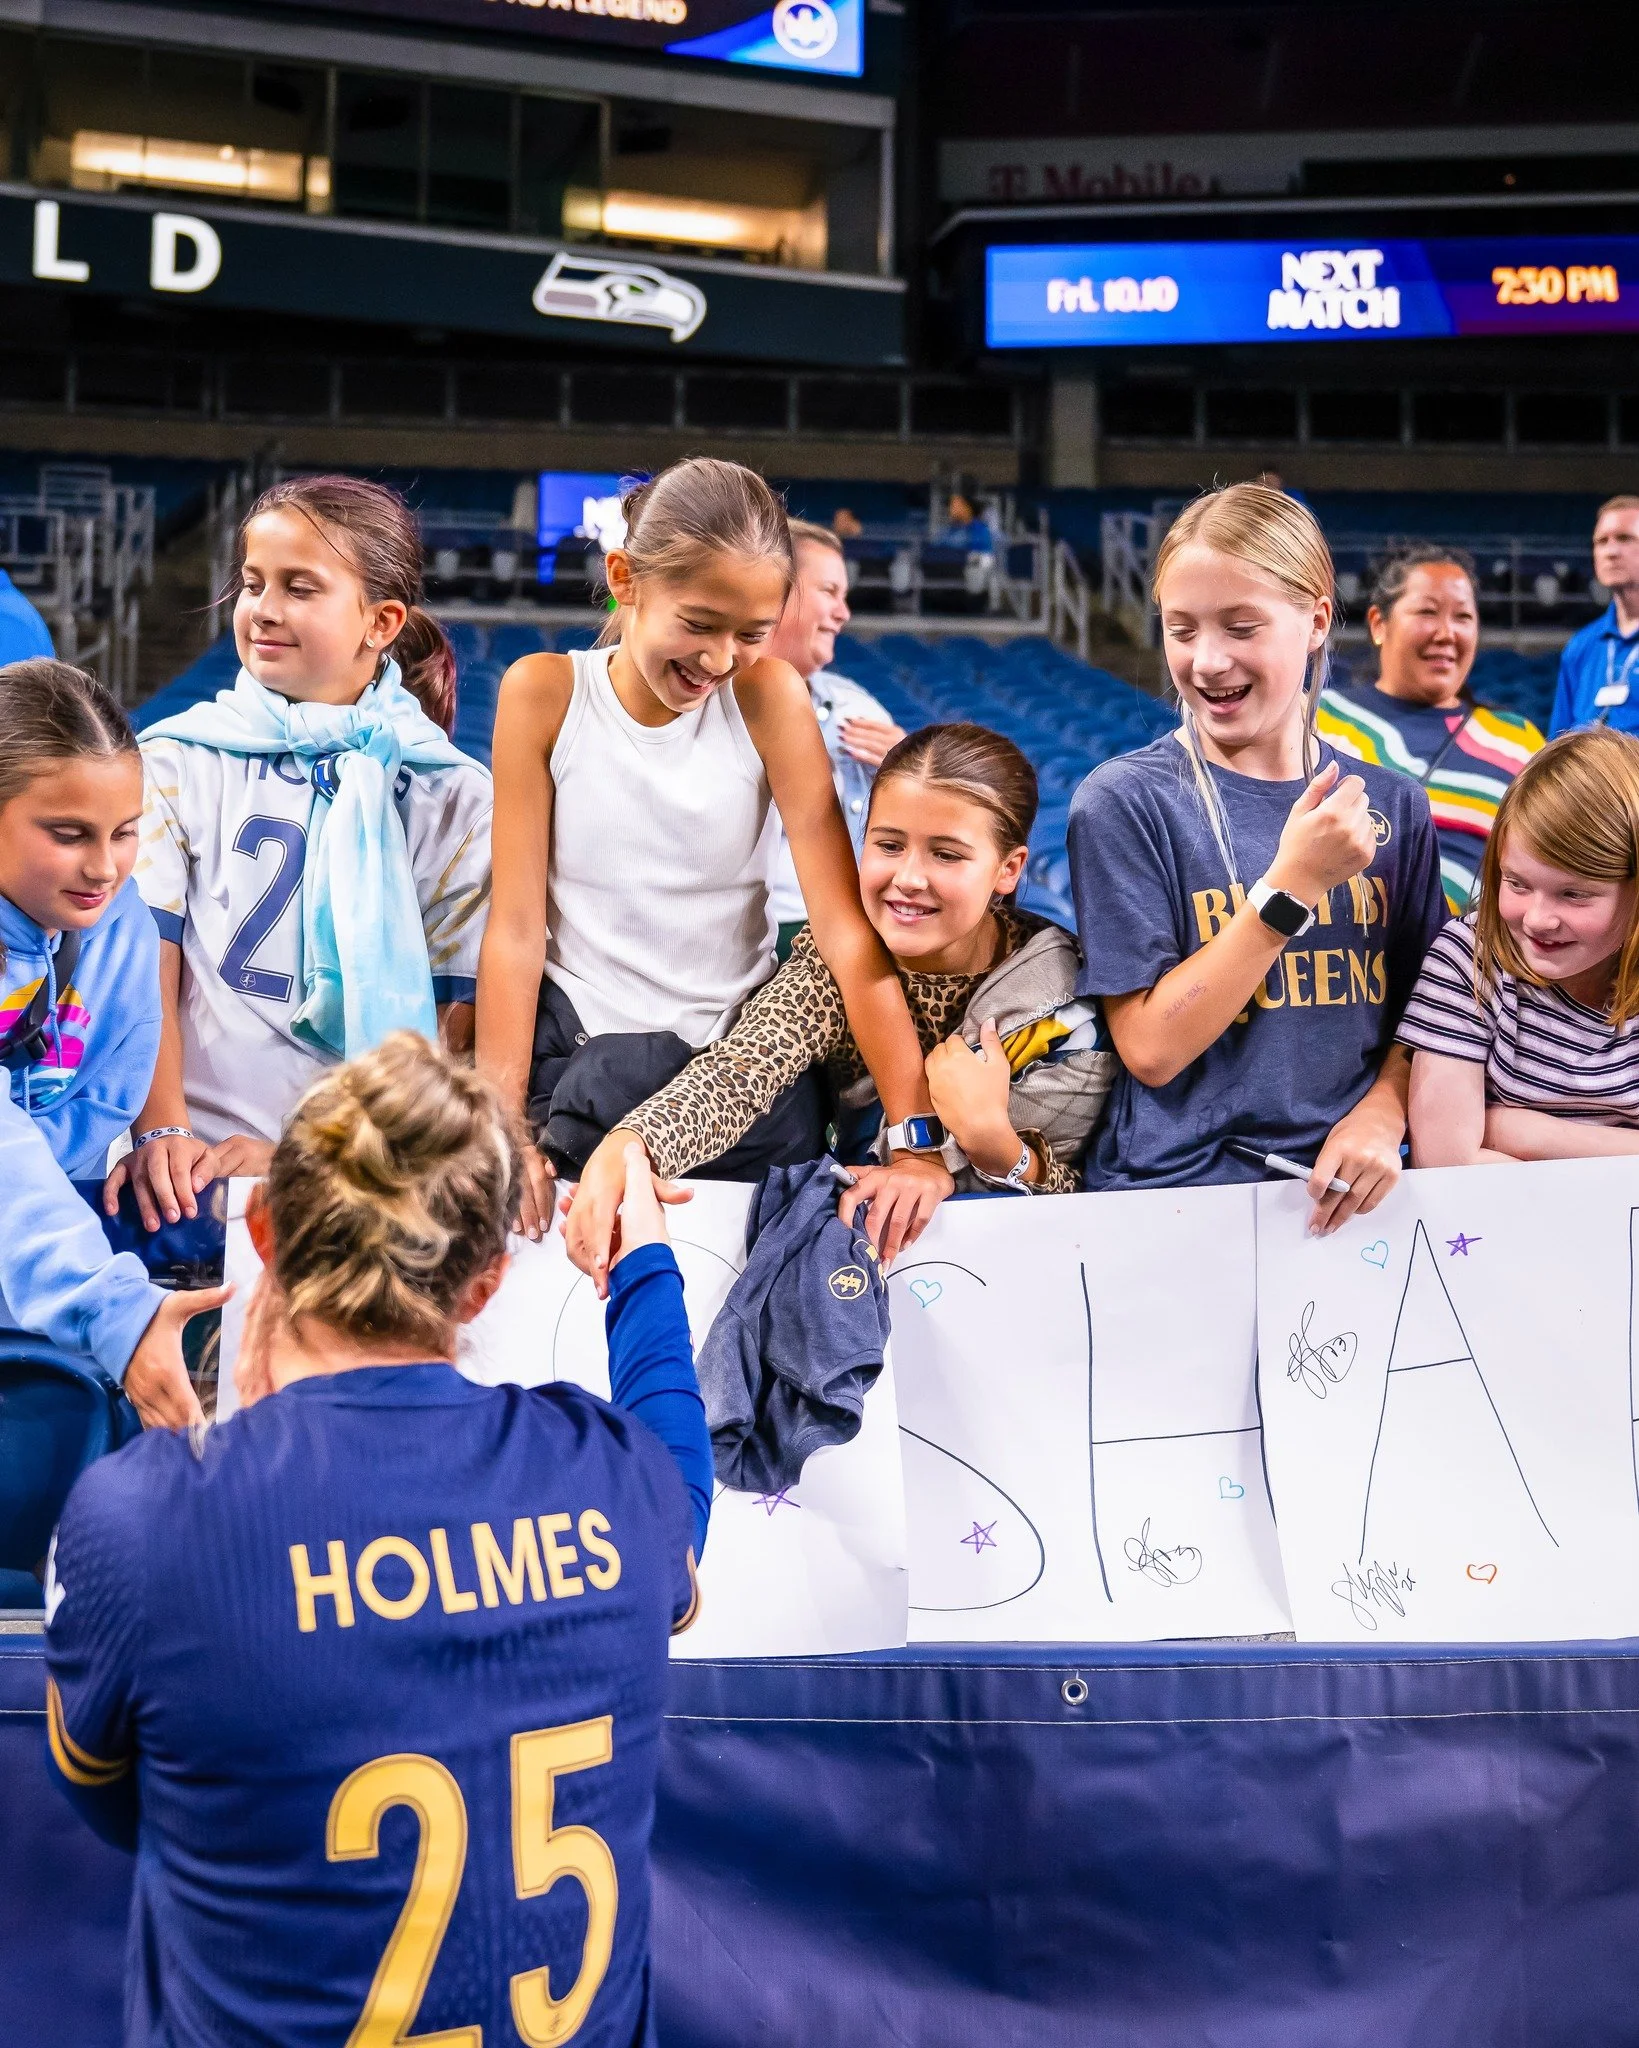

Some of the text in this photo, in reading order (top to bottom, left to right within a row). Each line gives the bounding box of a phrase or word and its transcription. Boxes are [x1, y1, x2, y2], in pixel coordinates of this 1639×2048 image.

[1281, 249, 1384, 291] NEXT
[1566, 265, 1620, 303] PM
[1267, 287, 1401, 330] MATCH
[1234, 948, 1388, 1025] UEENS
[289, 1508, 622, 1634] HOLMES
[325, 1714, 619, 2048] 25
